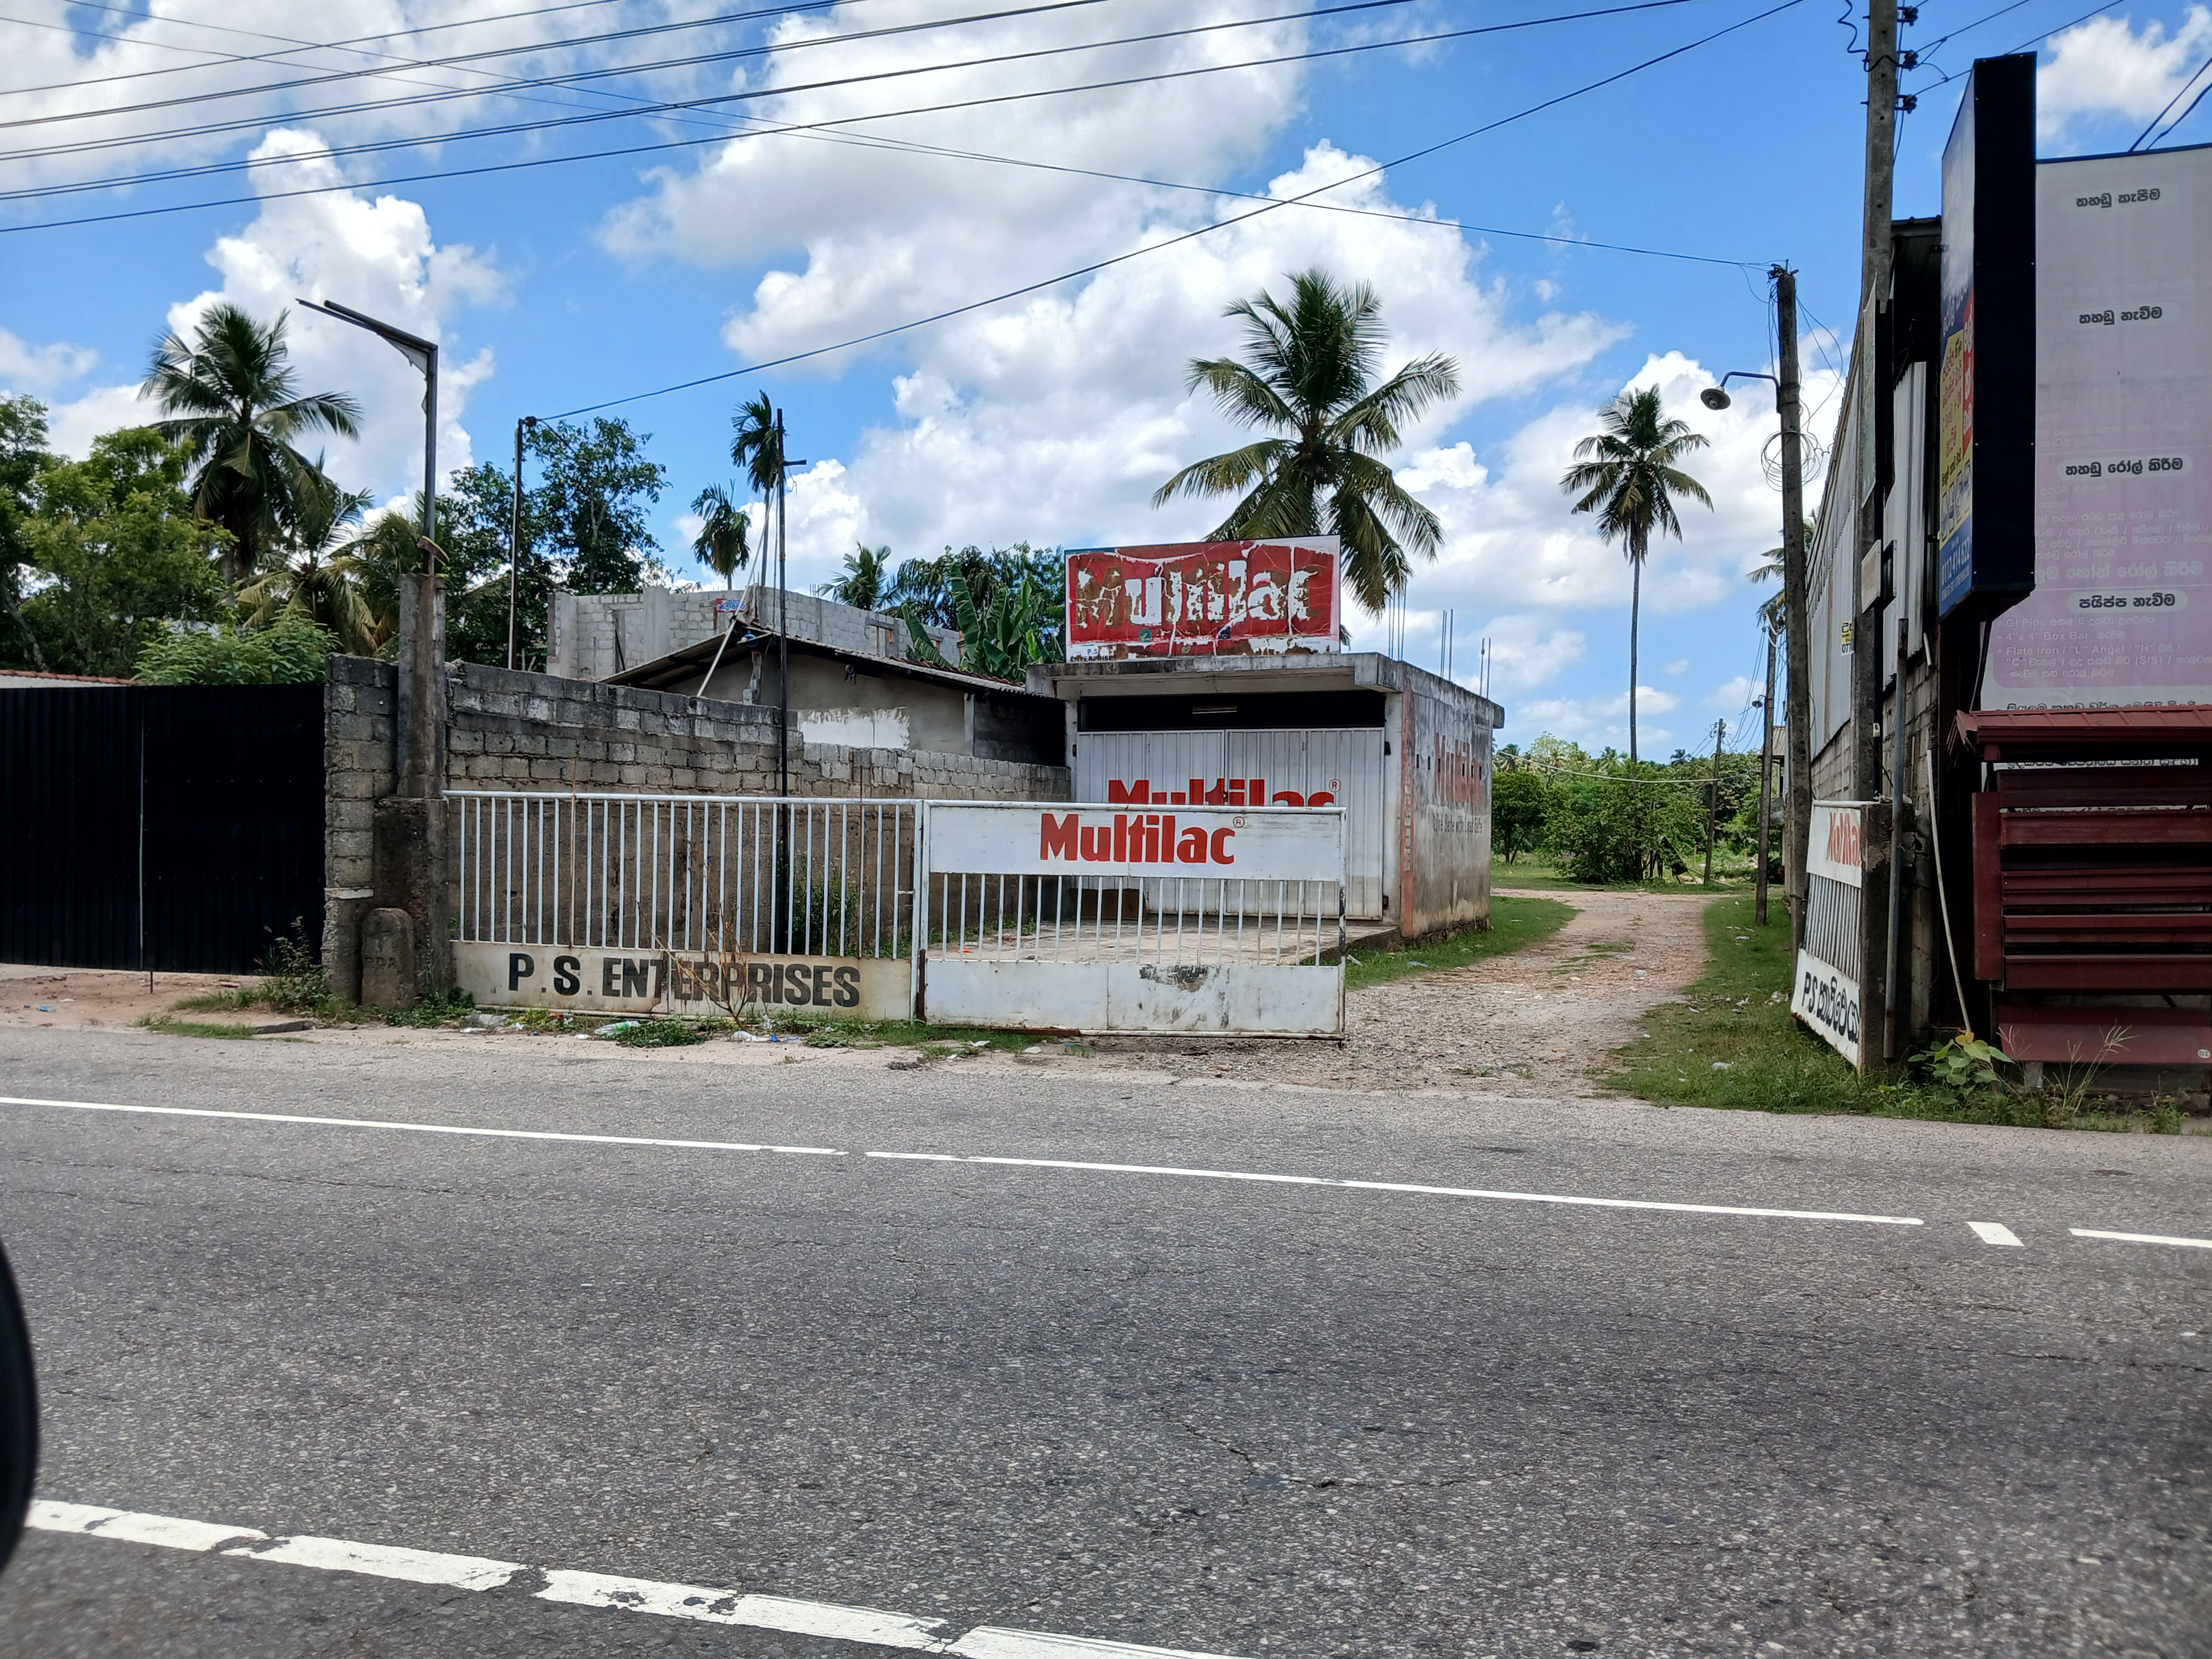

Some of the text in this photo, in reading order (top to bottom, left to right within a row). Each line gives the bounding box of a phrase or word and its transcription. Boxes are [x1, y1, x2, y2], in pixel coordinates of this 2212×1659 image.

[1040, 813, 1236, 865] Multilac
[1826, 812, 1861, 867] Multila
[602, 956, 860, 1008] ENTERPRISES
